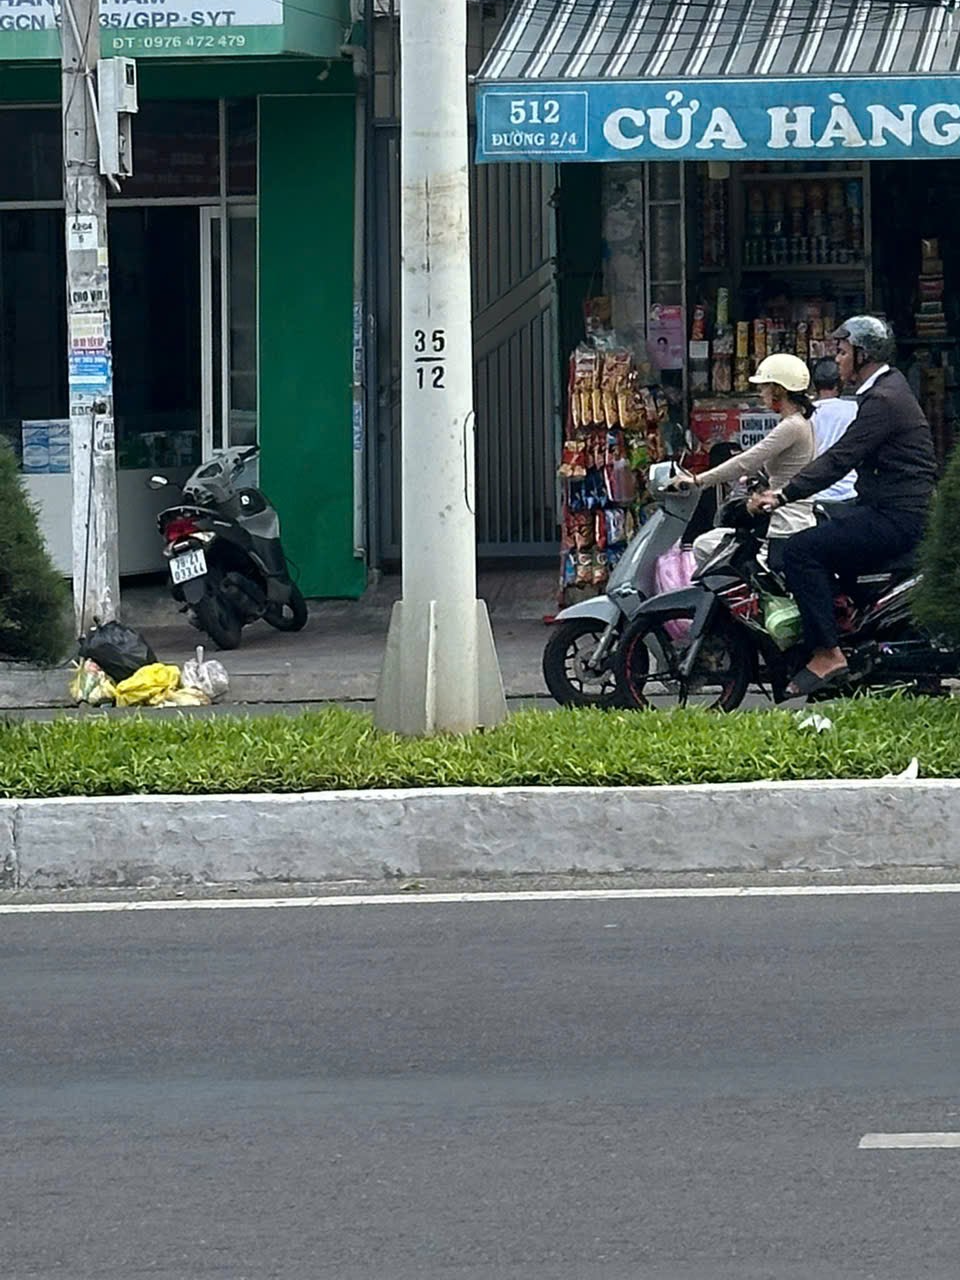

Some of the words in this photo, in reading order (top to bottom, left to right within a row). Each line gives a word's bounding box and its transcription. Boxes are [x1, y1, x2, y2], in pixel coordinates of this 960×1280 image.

[144, 36, 182, 48] 0976
[186, 35, 214, 48] 472
[218, 34, 245, 47] 479
[510, 99, 560, 125] 512
[602, 89, 747, 150] CỬA
[492, 127, 545, 147] ĐƯỜNG
[550, 128, 577, 146] 2/4
[414, 329, 445, 352] 35
[416, 366, 445, 389] 12
